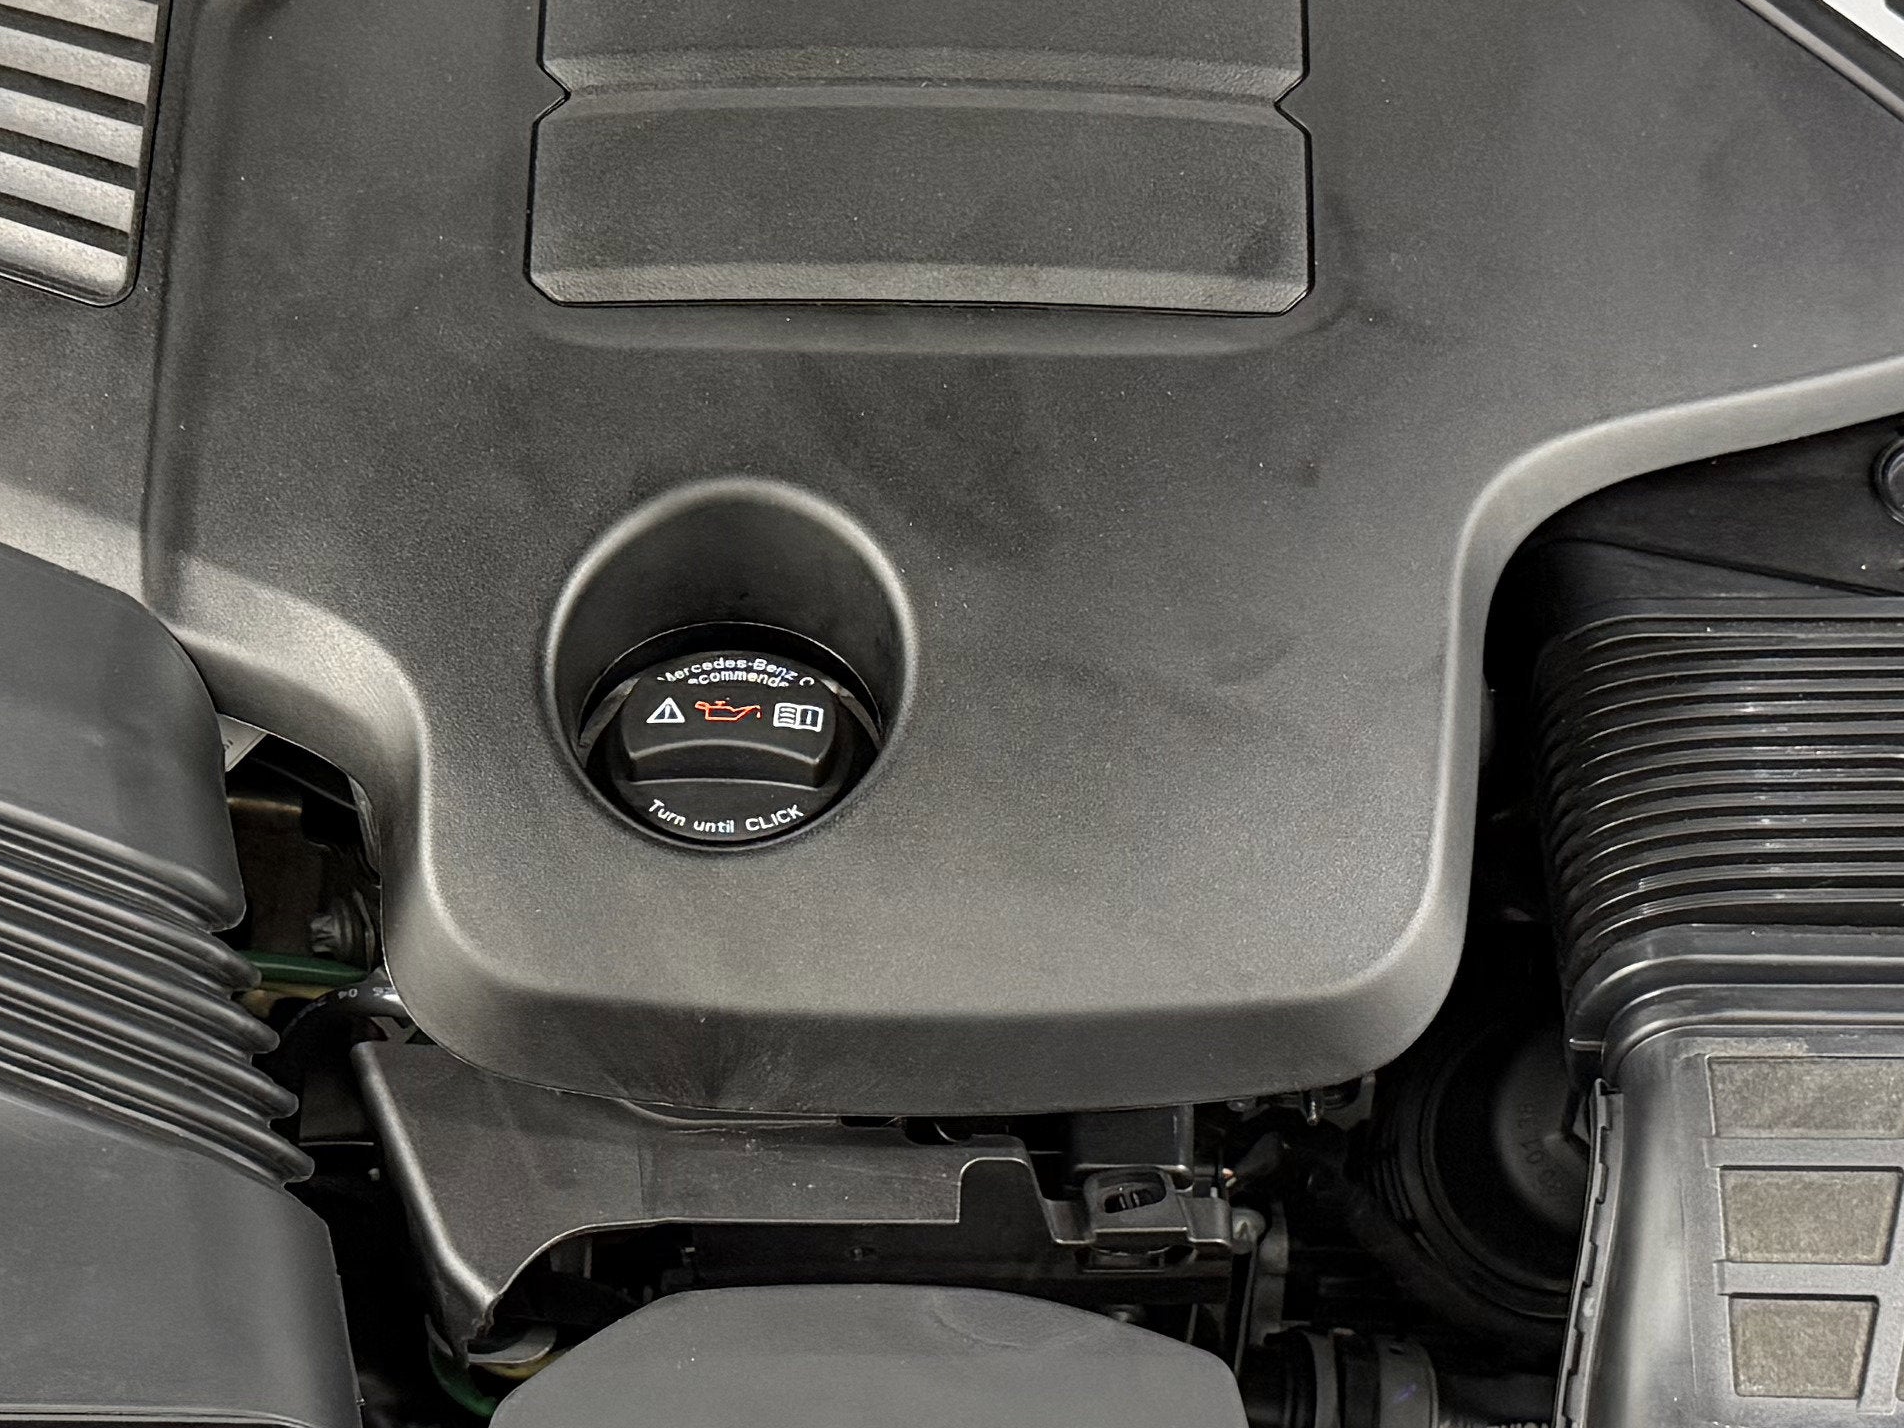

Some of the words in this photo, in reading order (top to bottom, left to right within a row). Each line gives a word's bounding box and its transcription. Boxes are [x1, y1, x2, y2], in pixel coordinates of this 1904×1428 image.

[648, 799, 686, 827] Turn
[694, 820, 735, 834] until
[745, 804, 805, 832] CLICK
